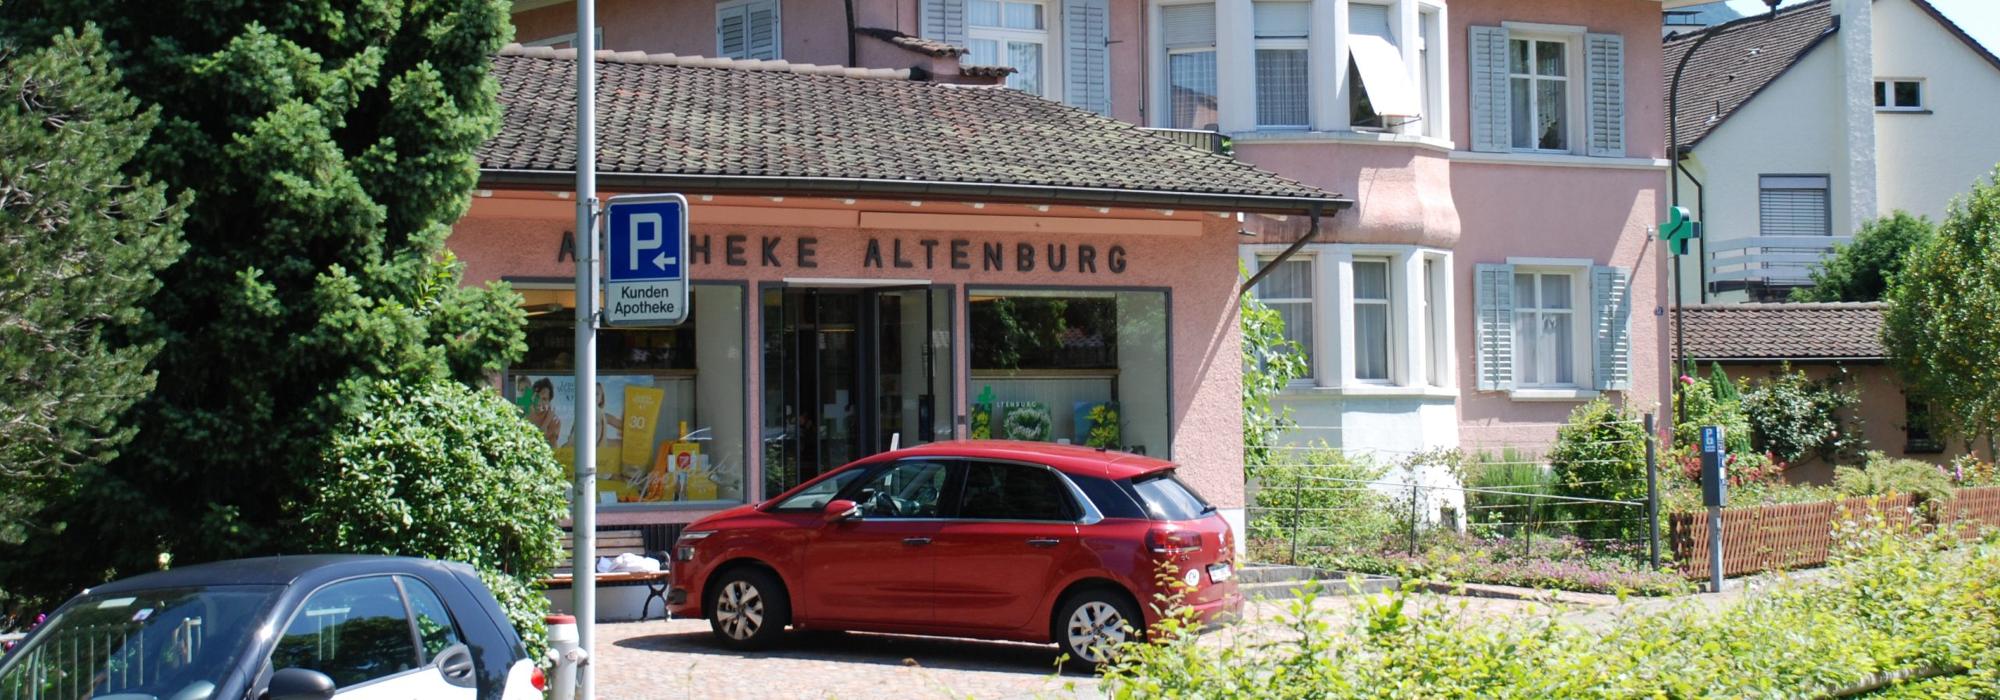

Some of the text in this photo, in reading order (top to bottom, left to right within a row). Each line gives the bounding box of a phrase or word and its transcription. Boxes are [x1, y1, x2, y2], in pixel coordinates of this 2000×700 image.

[629, 212, 663, 271] P
[558, 231, 1127, 274] AHEKE ALTENBURG
[621, 285, 669, 299] Kunden
[614, 301, 674, 316] Apotheke
[629, 416, 645, 429] 30
